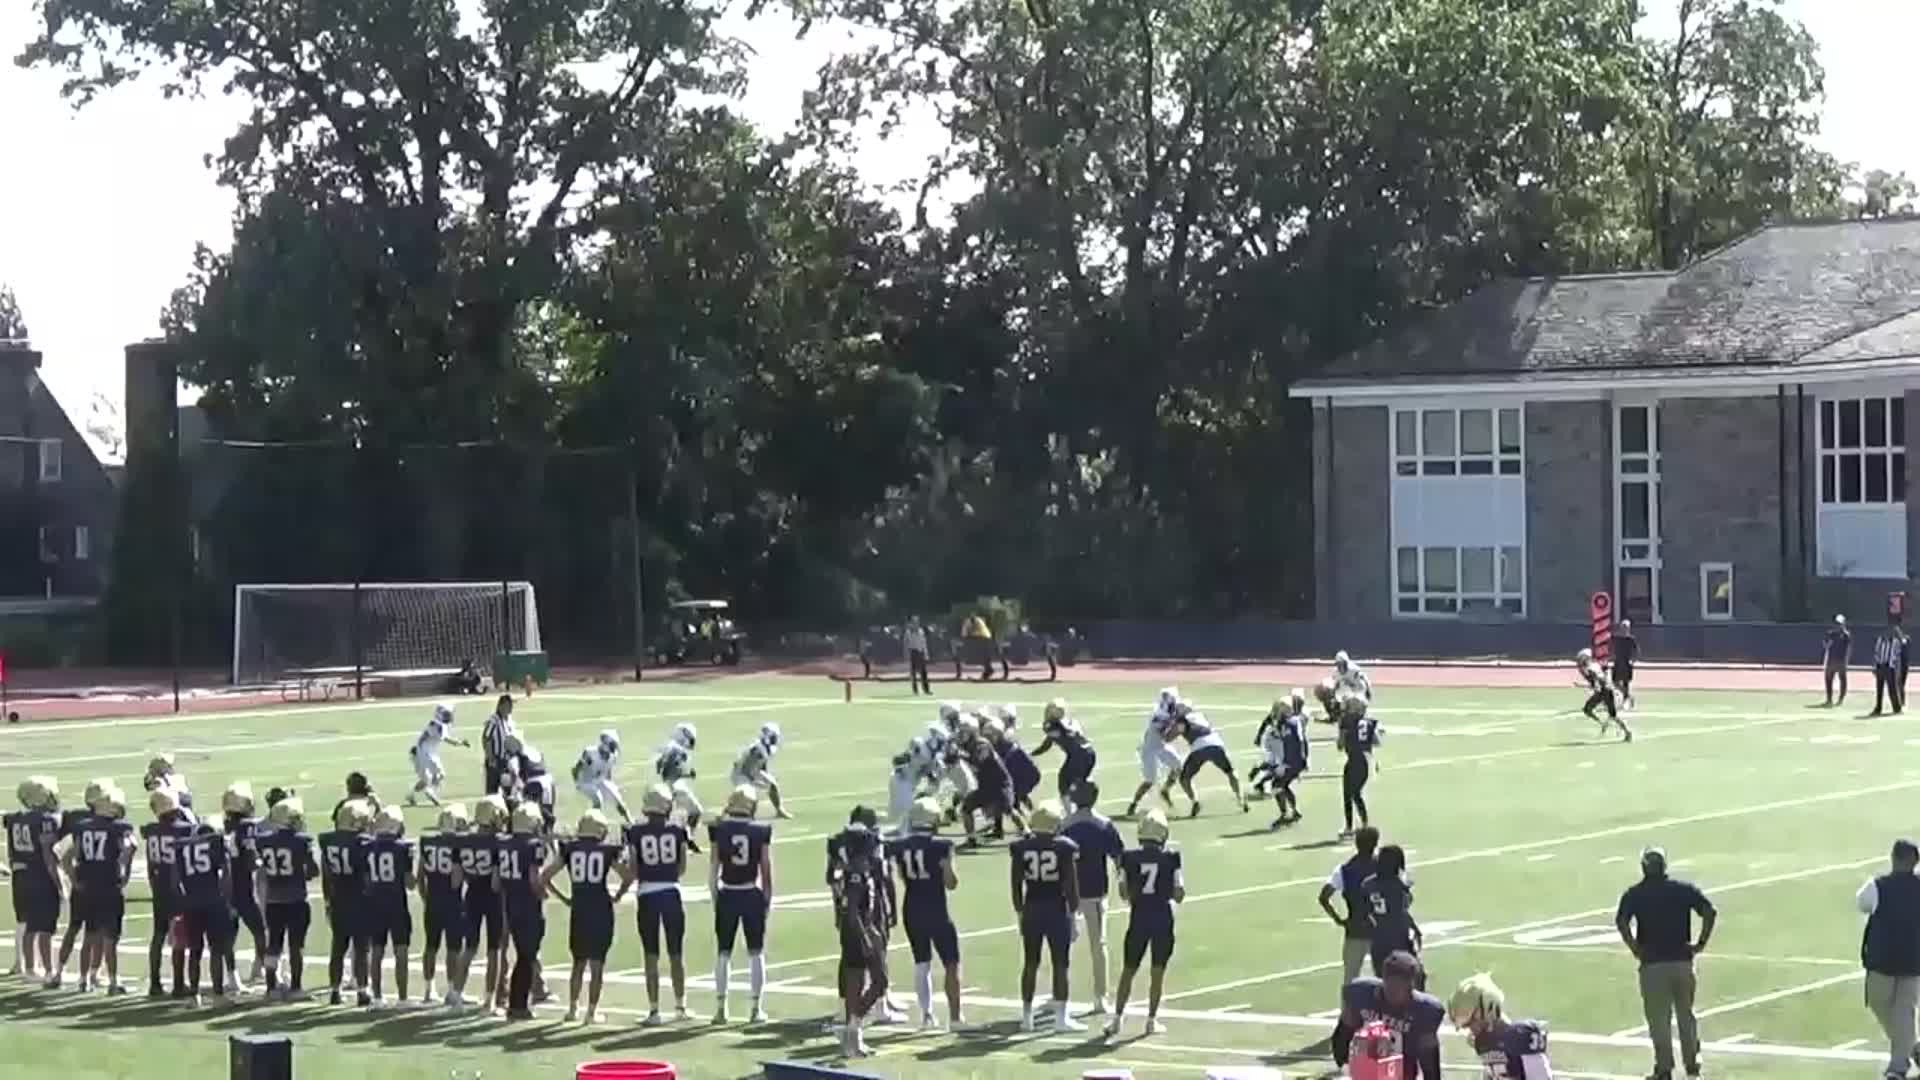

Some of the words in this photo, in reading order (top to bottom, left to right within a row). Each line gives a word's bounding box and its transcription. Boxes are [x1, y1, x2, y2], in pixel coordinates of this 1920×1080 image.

[1357, 719, 1369, 742] 2
[82, 830, 107, 860] 87
[148, 836, 175, 864] 85
[182, 842, 211, 876] 15
[327, 845, 353, 875] 51
[424, 845, 452, 874] 36
[641, 833, 676, 865] 88
[731, 834, 749, 865] 3
[263, 848, 293, 875] 33
[368, 851, 396, 882] 18
[460, 849, 492, 875] 22
[499, 850, 522, 880] 21
[570, 851, 604, 883] 80
[903, 850, 930, 880] 11
[1024, 850, 1059, 881] 32
[1140, 863, 1158, 894] 7
[1370, 892, 1387, 914] 5
